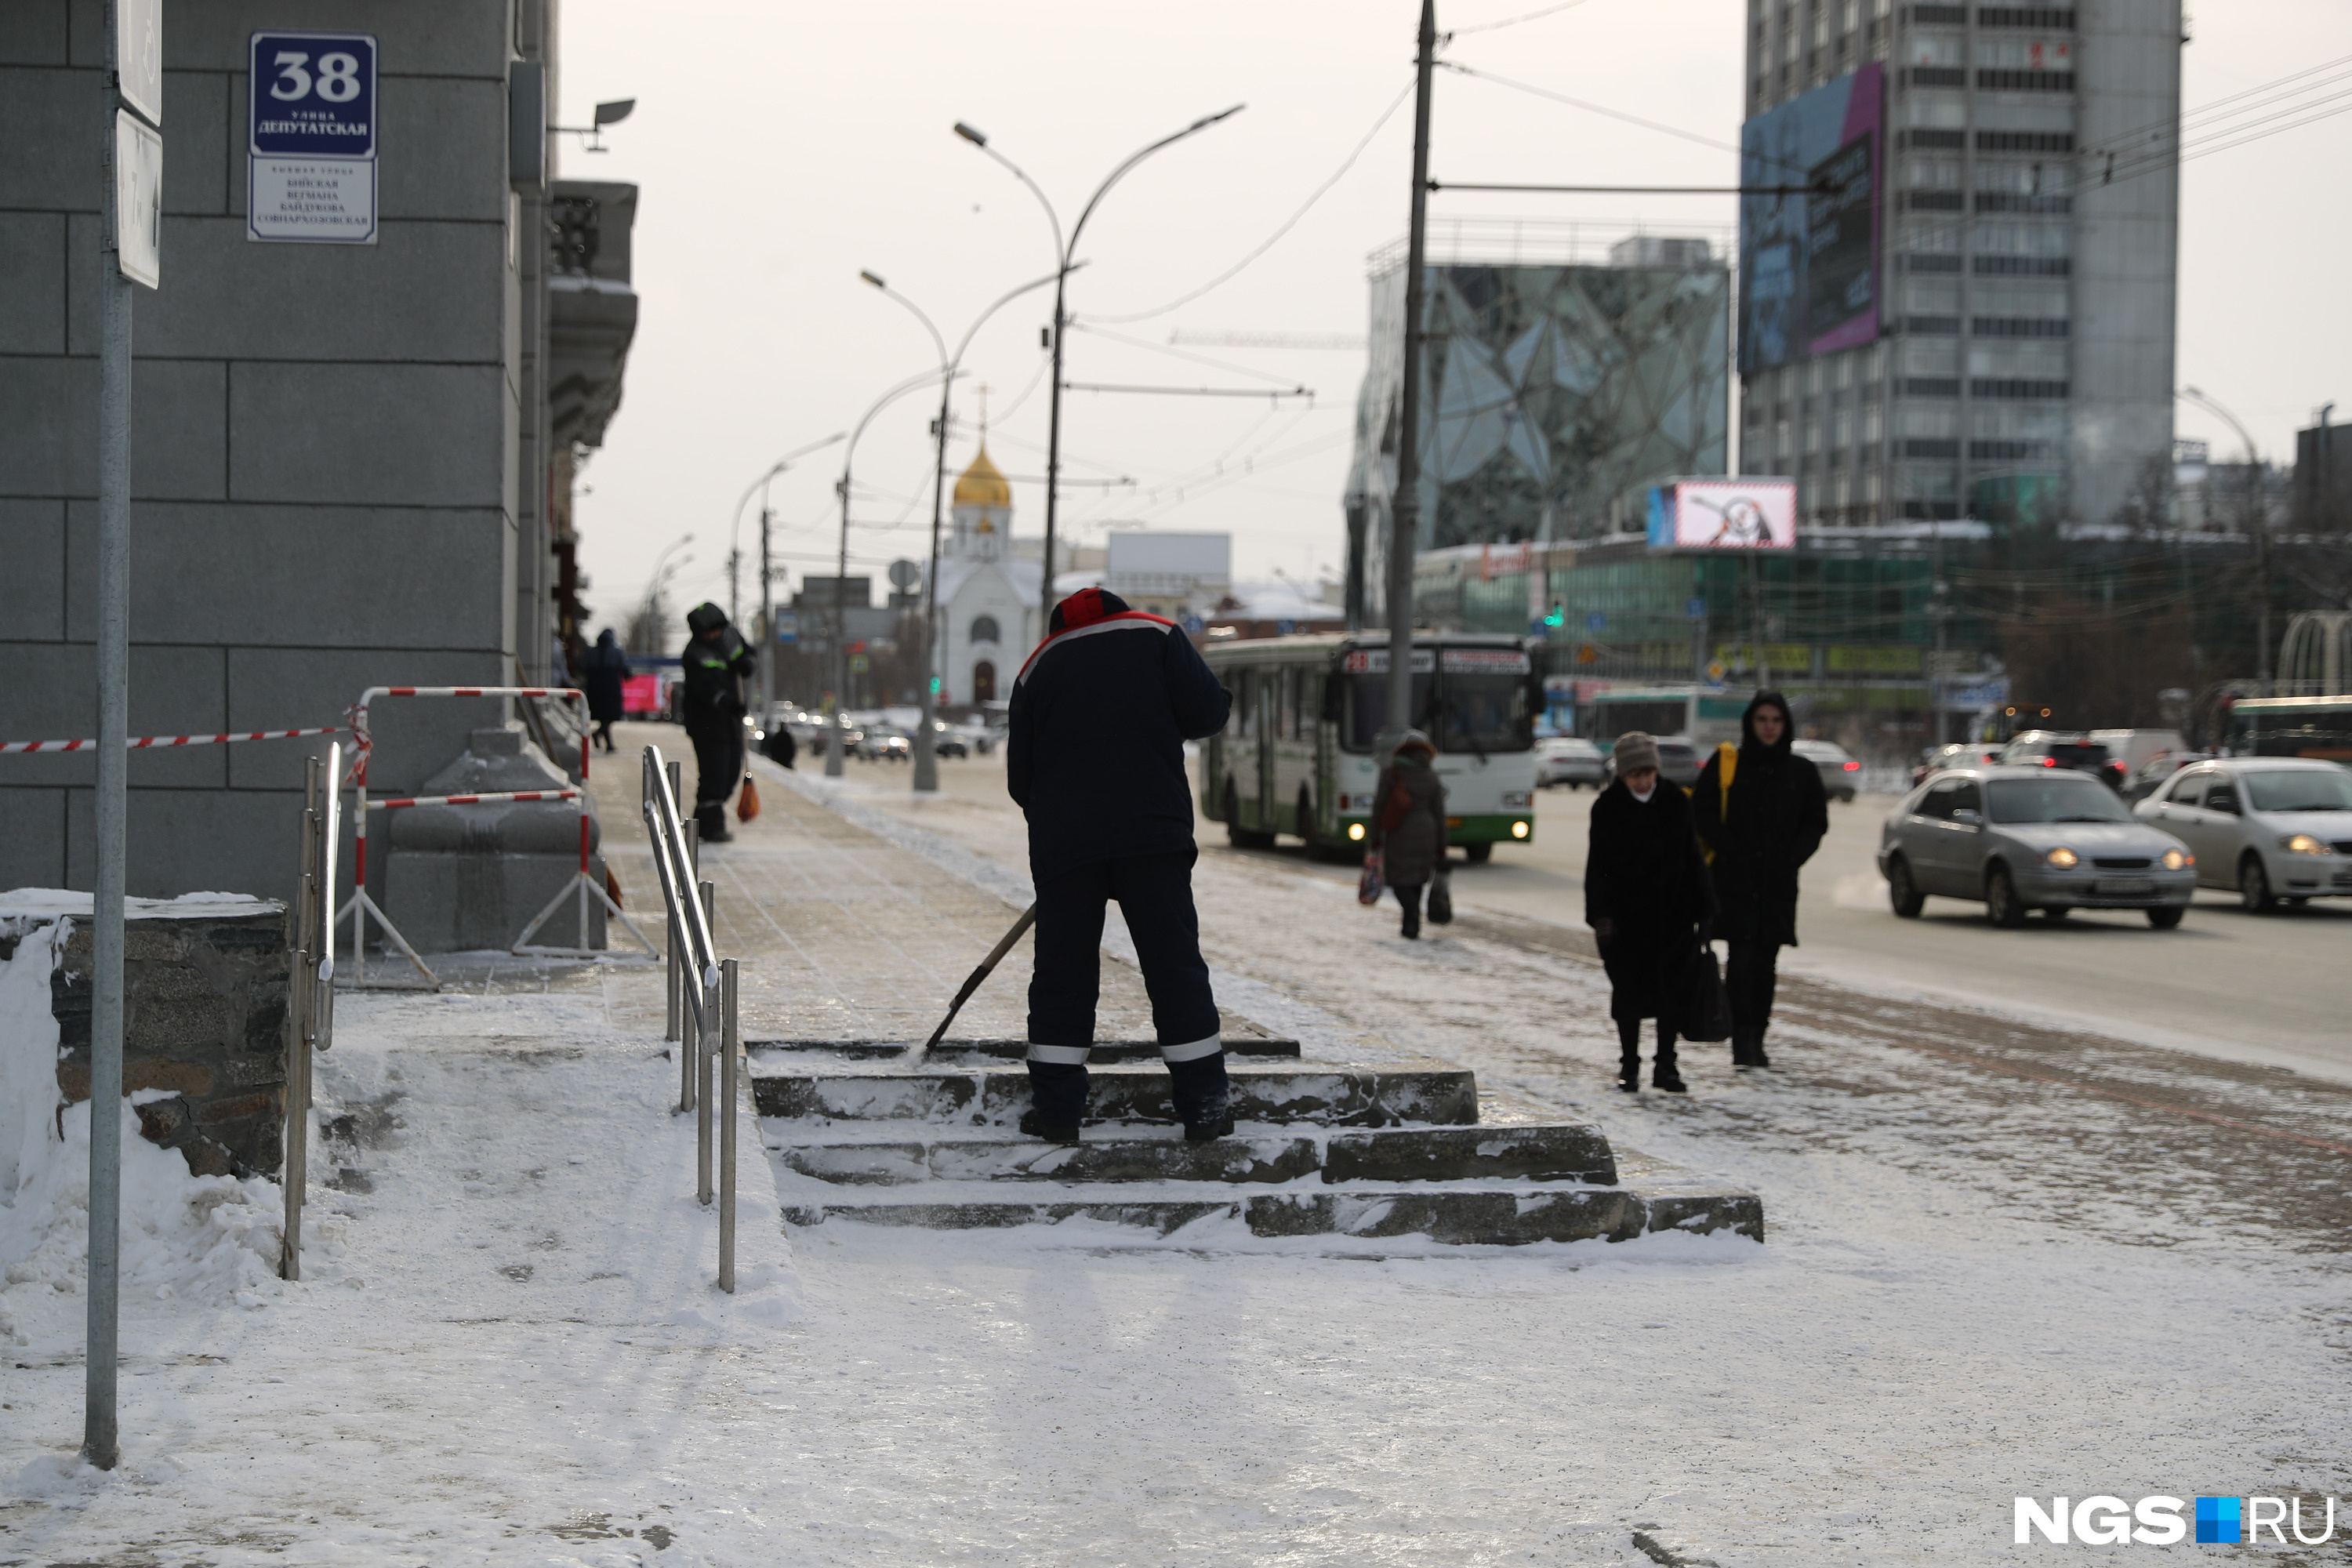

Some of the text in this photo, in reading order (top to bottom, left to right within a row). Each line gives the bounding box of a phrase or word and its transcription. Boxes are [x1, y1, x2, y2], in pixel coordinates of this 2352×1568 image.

[270, 50, 361, 103] 38
[291, 110, 336, 121] УЛИЦА
[258, 120, 368, 136] ДЕПУТАТСКАЯ
[287, 176, 339, 188] БИЙСКАЯ
[287, 190, 339, 201] ВЕГМАНА
[280, 201, 345, 212] БАЙДУКОВА
[256, 214, 368, 226] СОВНАРХОЗОВСКАЯ
